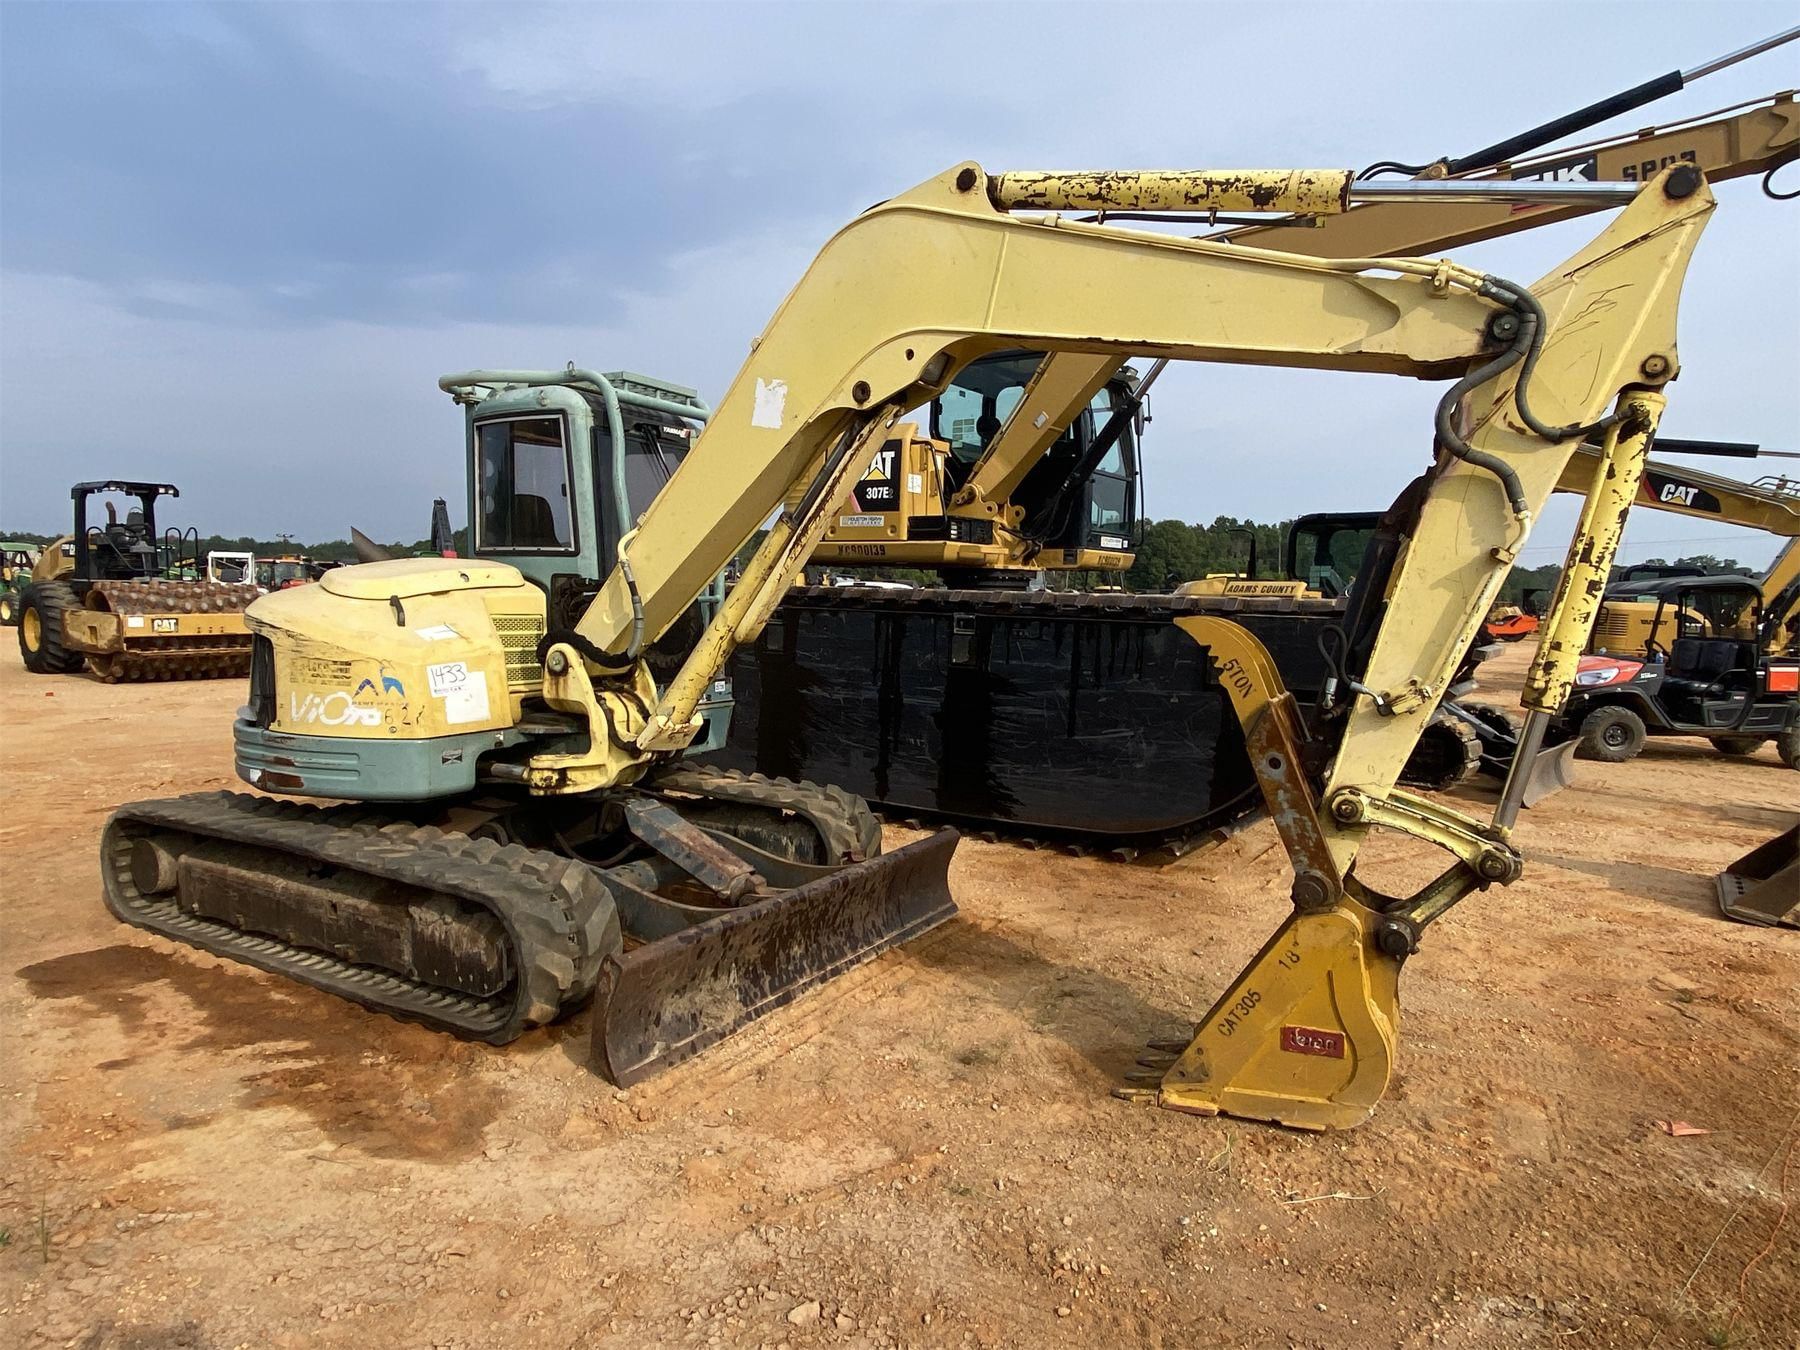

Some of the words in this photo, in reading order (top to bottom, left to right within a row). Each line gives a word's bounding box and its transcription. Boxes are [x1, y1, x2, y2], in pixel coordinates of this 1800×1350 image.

[860, 451, 895, 480] AT
[1660, 483, 1699, 506] CAT
[1227, 584, 1258, 593] ADAMS
[1260, 585, 1297, 594] COUNTY
[153, 619, 177, 632] CAT
[430, 664, 467, 687] 1433
[1222, 658, 1253, 699] 5TON
[1217, 987, 1262, 1038] CAT305
